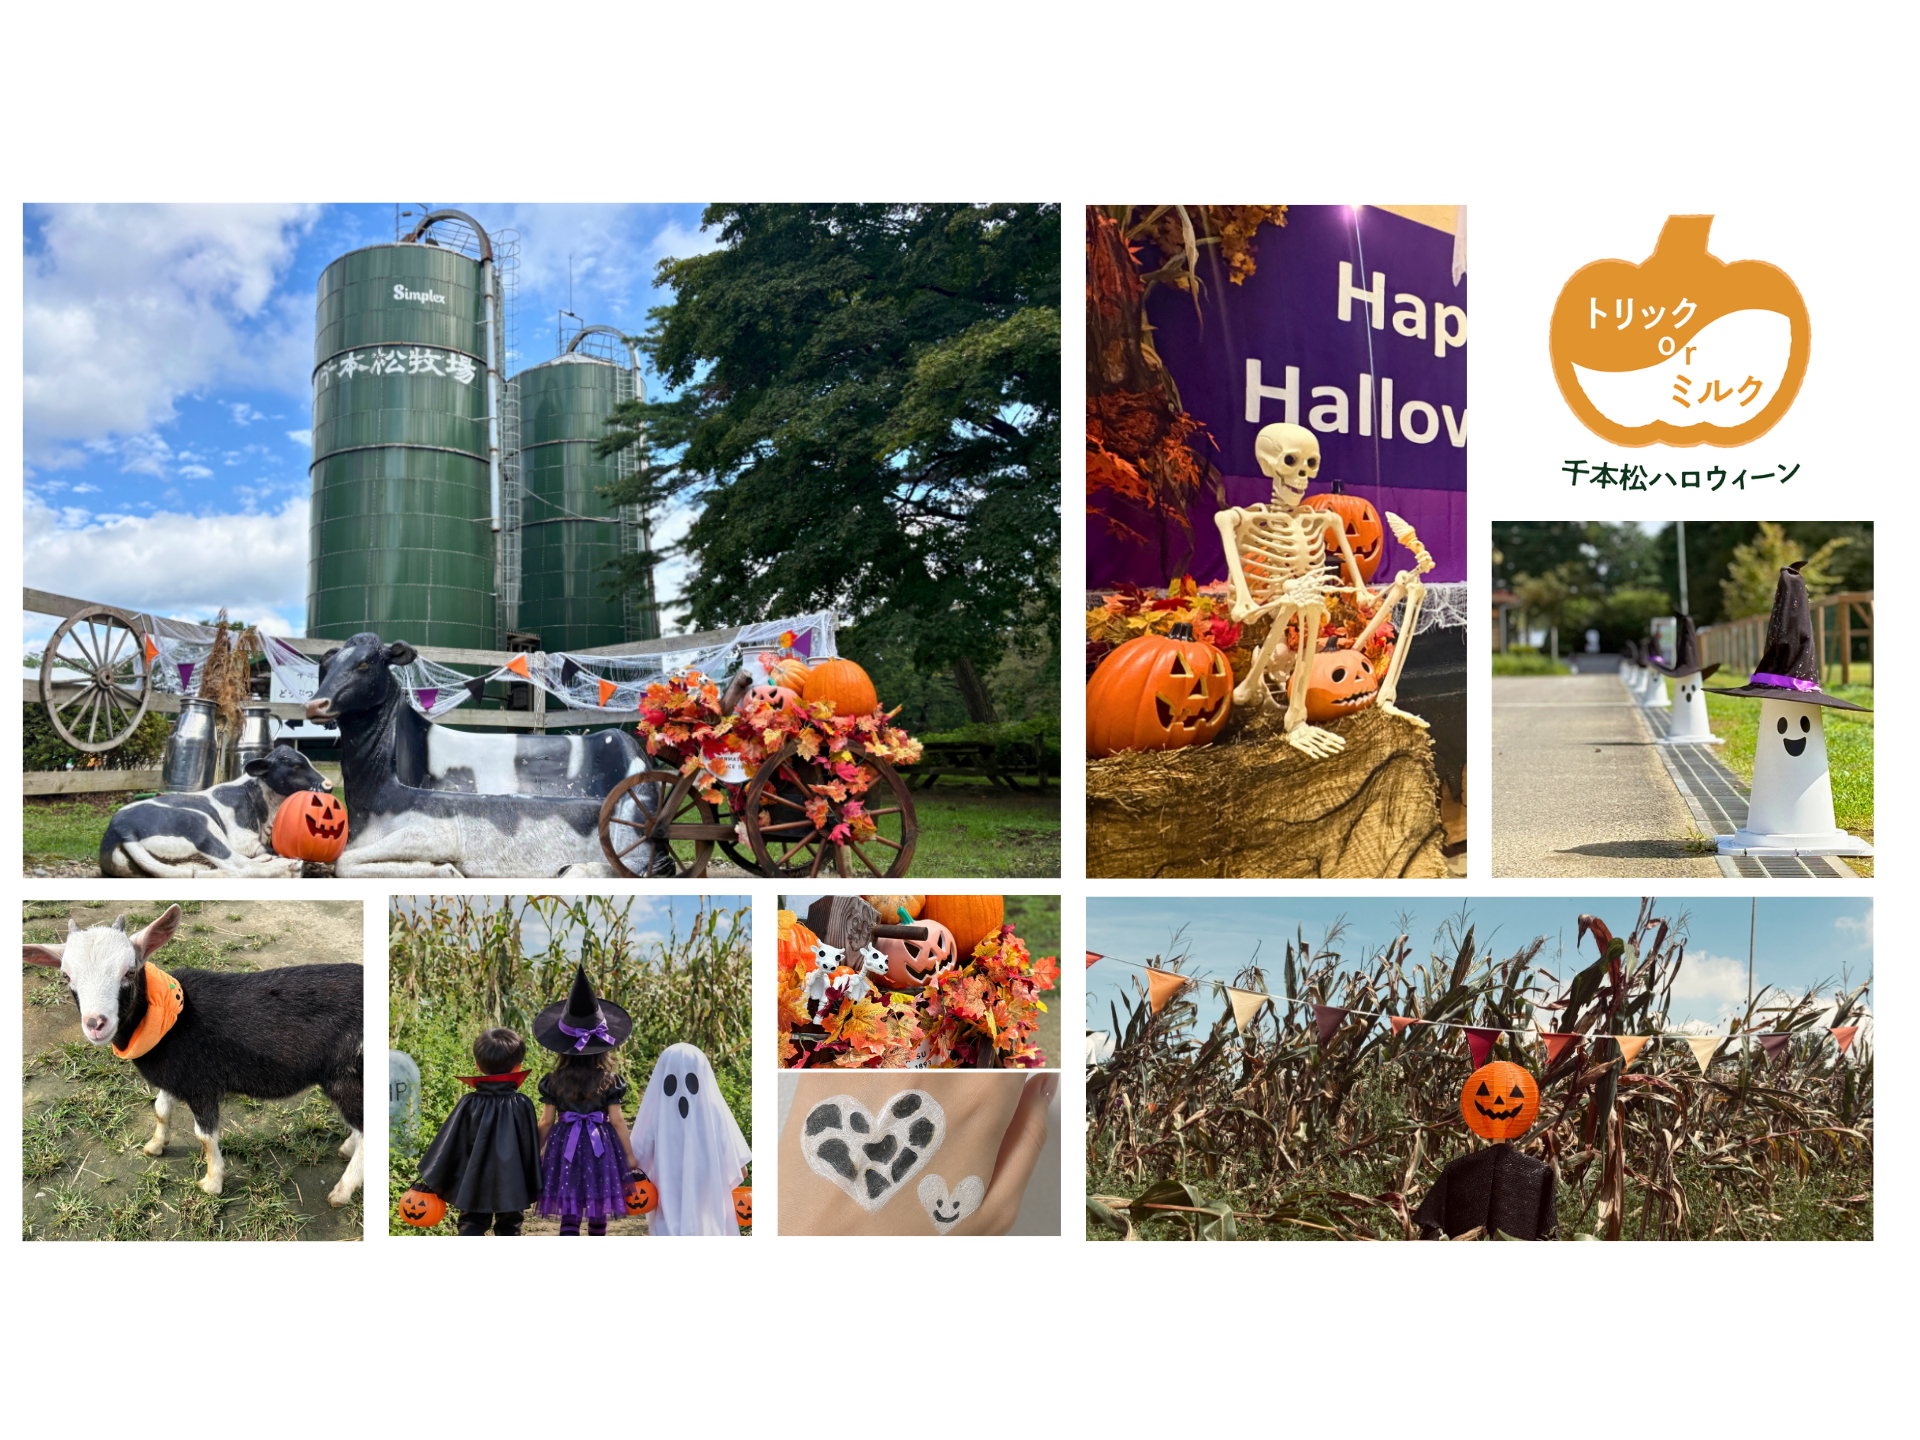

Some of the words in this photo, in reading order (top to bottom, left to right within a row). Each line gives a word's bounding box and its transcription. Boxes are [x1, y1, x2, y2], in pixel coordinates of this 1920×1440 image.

[393, 284, 446, 305] Simplex
[320, 346, 477, 387] 千本松牧場
